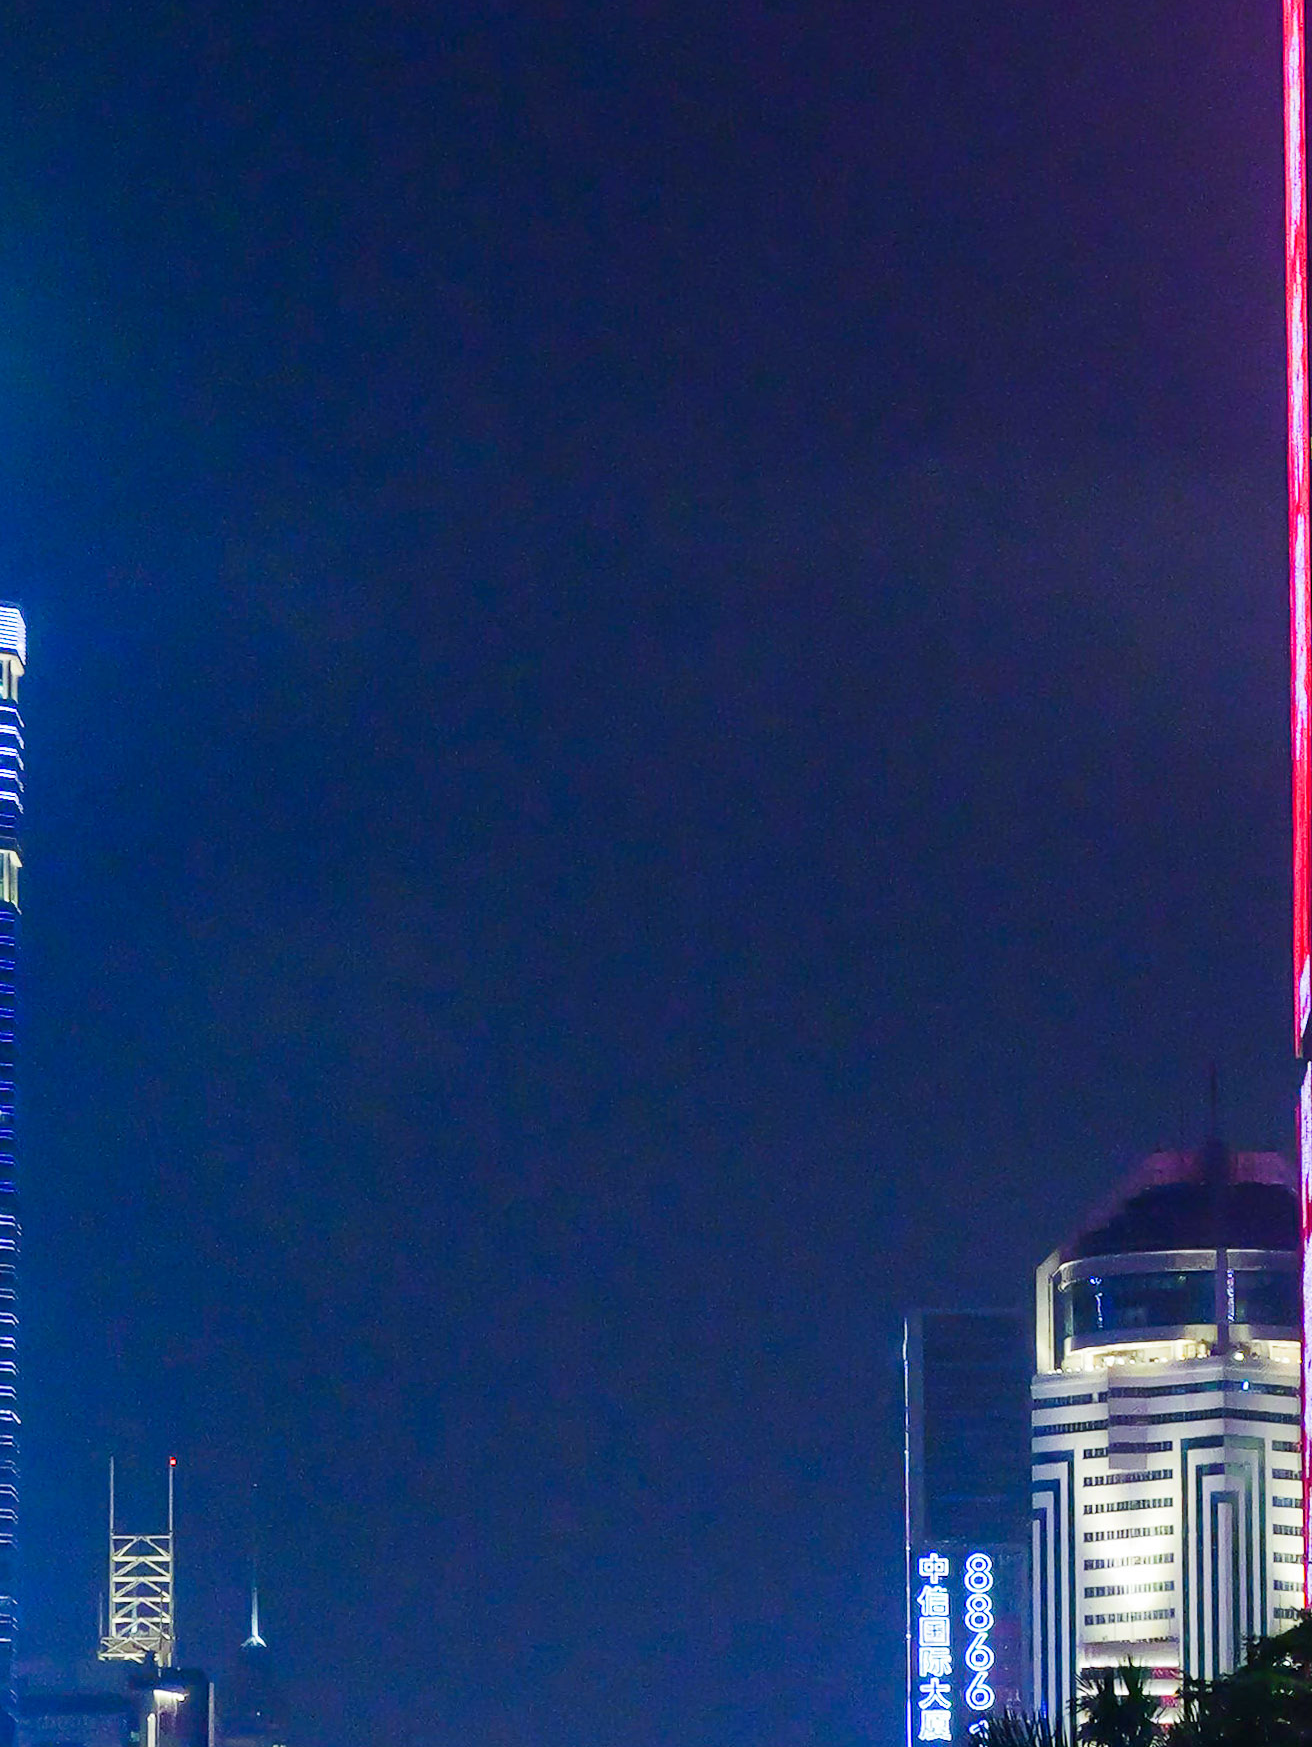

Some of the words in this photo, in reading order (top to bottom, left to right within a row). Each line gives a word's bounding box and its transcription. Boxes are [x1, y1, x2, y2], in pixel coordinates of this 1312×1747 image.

[917, 1552, 954, 1742] 中信国际大厦
